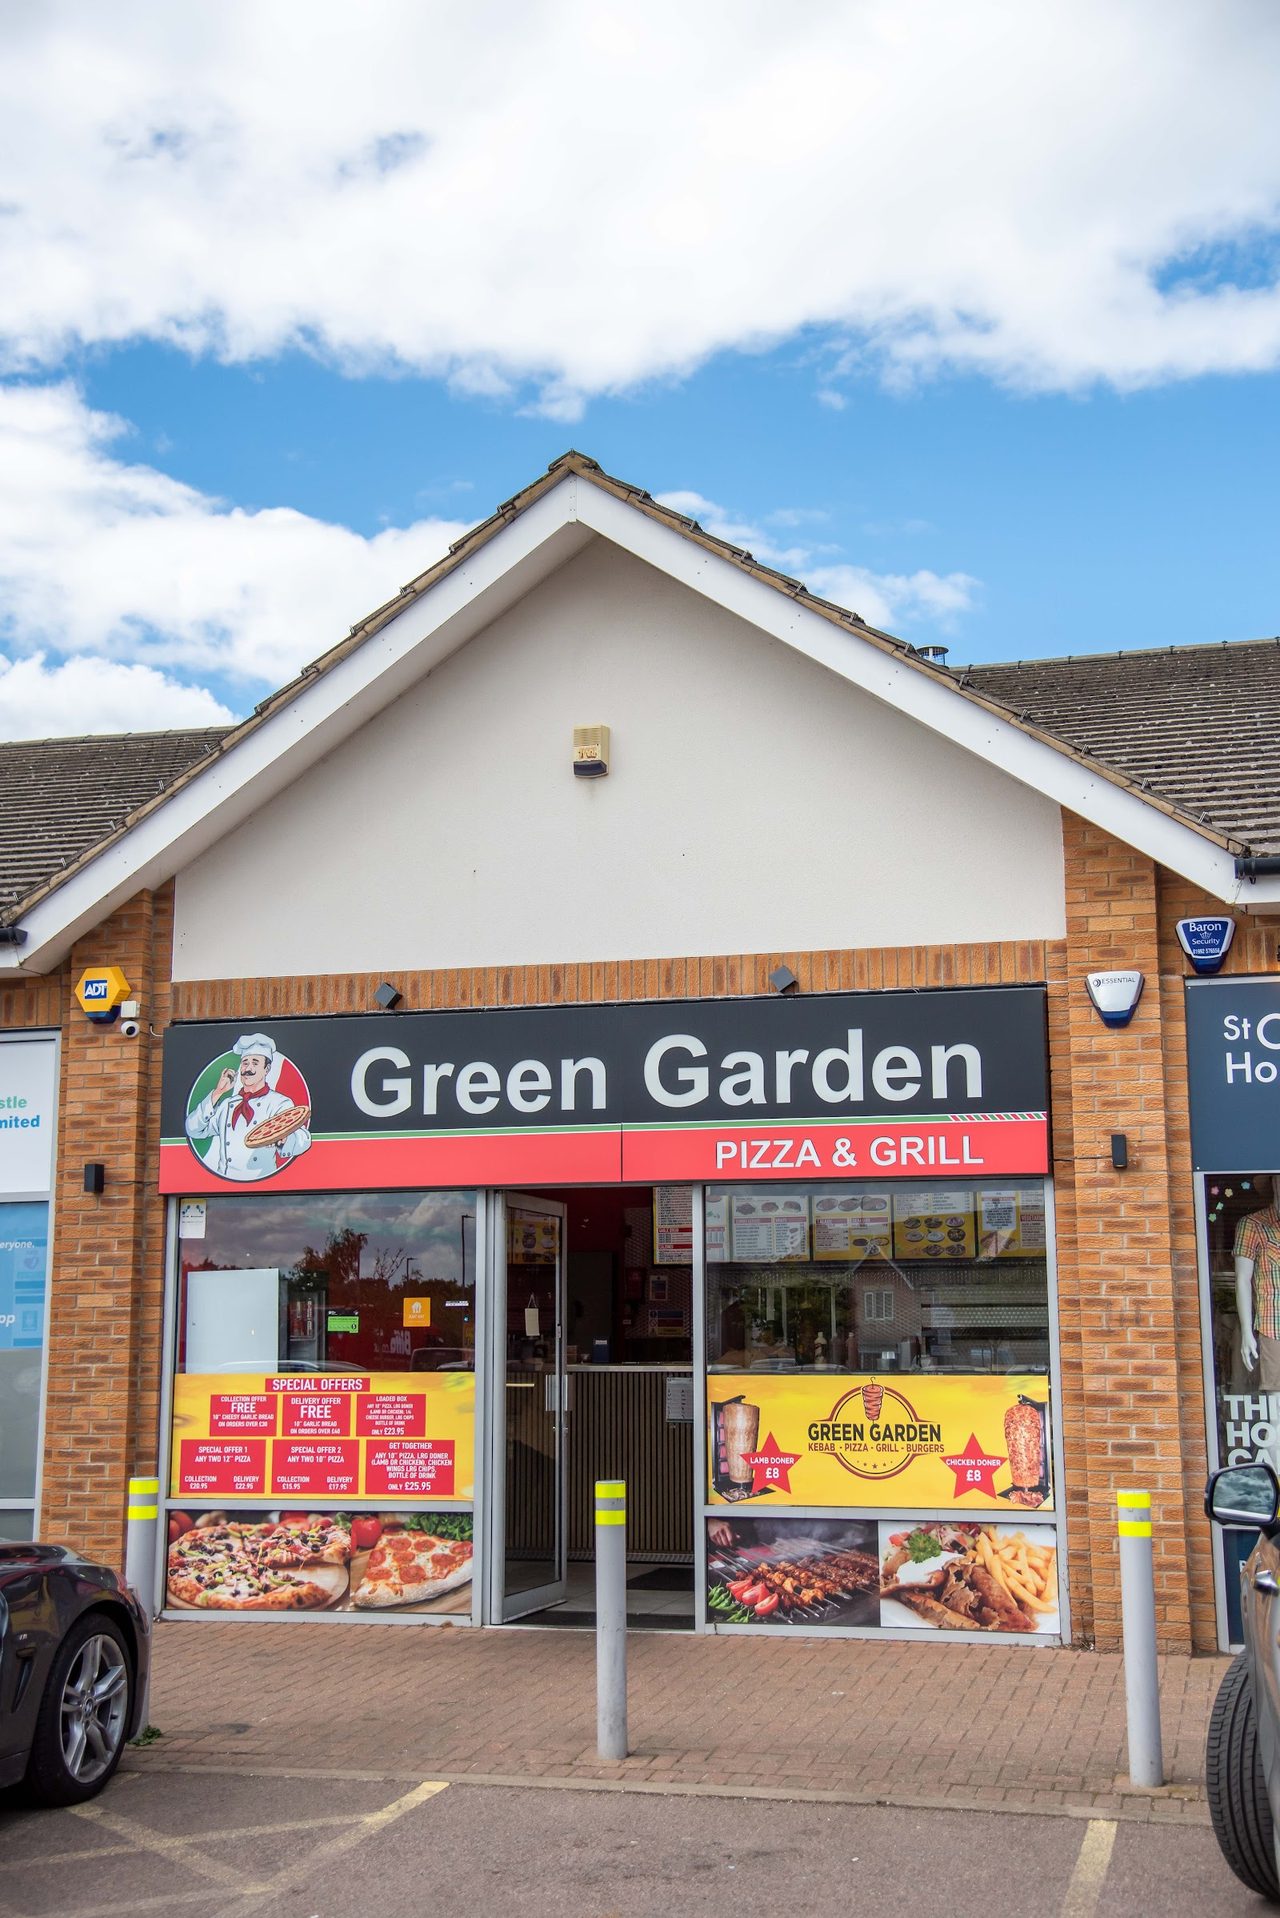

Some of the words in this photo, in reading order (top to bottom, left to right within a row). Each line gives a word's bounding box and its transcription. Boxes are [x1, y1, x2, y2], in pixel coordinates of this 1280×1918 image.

[1189, 922, 1222, 932] Baron
[1192, 938, 1220, 946] Security
[1102, 977, 1136, 985] ESSENTIAL
[85, 982, 107, 996] ADT
[1223, 1014, 1251, 1041] St
[351, 1046, 606, 1118] Green
[643, 1028, 983, 1108] Garden
[1225, 1051, 1278, 1084] Ho
[715, 1138, 821, 1169] PIZZA
[831, 1137, 857, 1167] &
[869, 1135, 984, 1166] GRILL
[272, 1379, 318, 1391] SPECIAL
[320, 1378, 363, 1390] OFFERS
[231, 1402, 256, 1413] FREE
[300, 1405, 331, 1418] FREE
[1223, 1394, 1280, 1420] THI
[384, 1427, 404, 1435] £23.95
[808, 1423, 865, 1441] GREEN
[869, 1424, 942, 1442] GARDEN
[1226, 1421, 1280, 1448] HO
[316, 1446, 337, 1454] OFFER
[337, 1446, 342, 1454] 2
[808, 1443, 836, 1452] KEBAB
[844, 1444, 868, 1452] PIZZA
[876, 1444, 899, 1452] GRILL
[906, 1444, 945, 1453] BURGERS
[946, 1458, 976, 1466] CHICKEN
[1227, 1448, 1280, 1474] CA
[765, 1467, 780, 1479] £8
[966, 1469, 982, 1482] £8
[235, 1482, 254, 1490] £22.95
[282, 1482, 300, 1490] £15.95
[404, 1482, 431, 1490] £25.95
